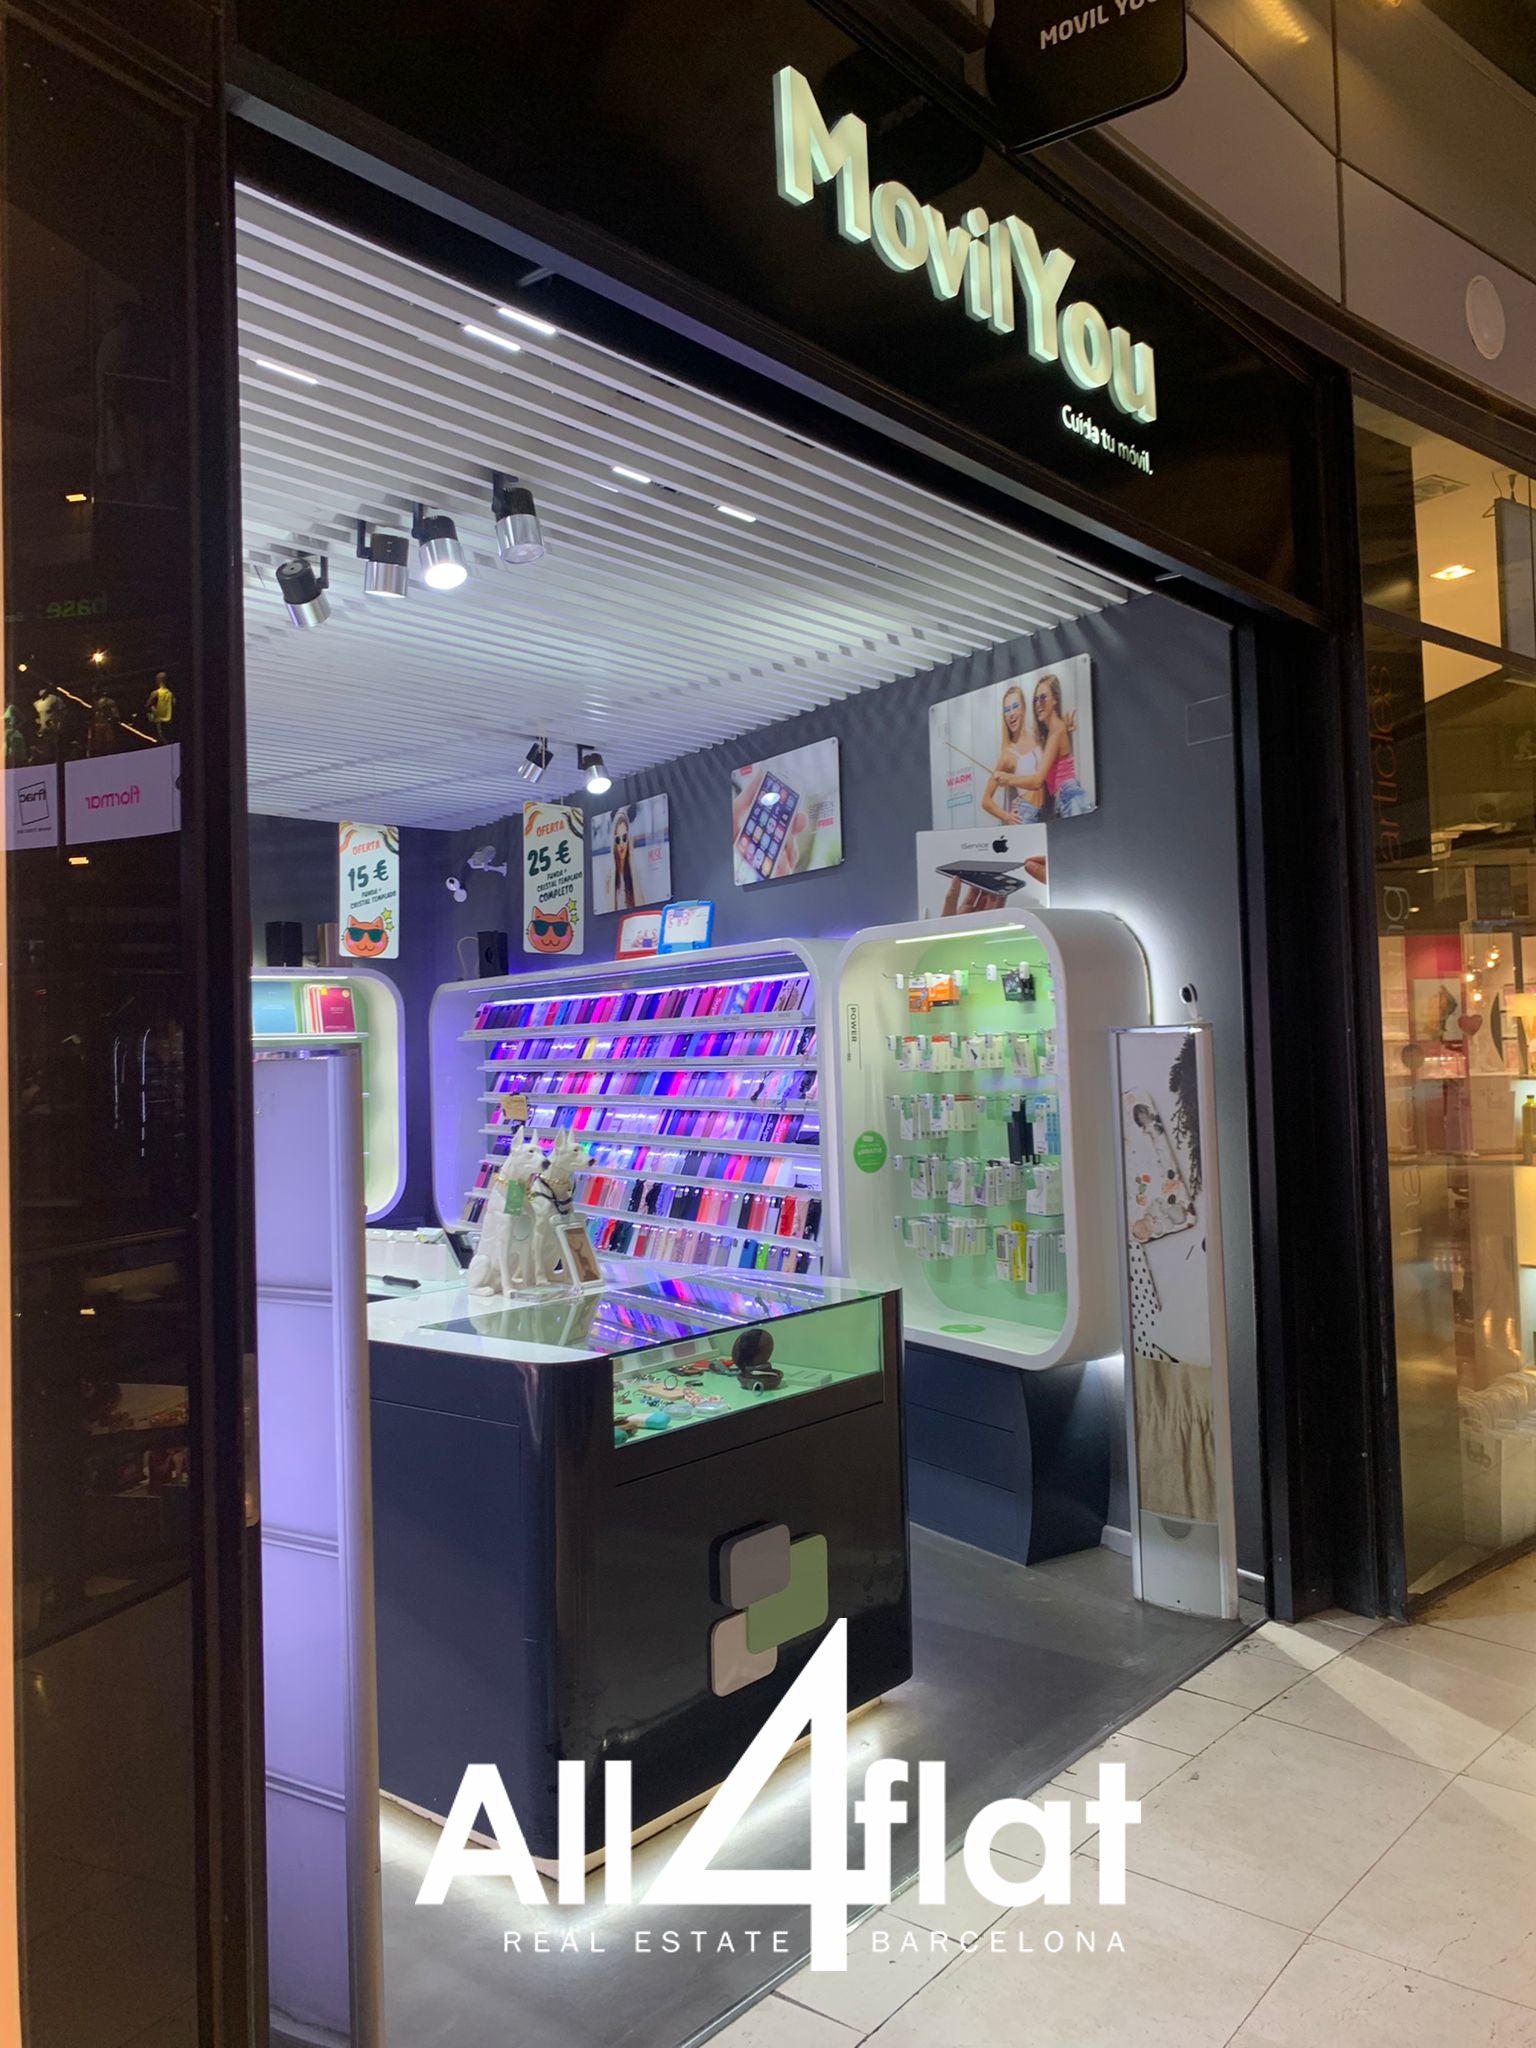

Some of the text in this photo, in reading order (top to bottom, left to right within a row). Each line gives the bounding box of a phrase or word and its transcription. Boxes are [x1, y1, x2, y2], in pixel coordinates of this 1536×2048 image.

[1040, 0, 1157, 50] MOVIL YO
[772, 65, 1157, 424] MovilYou
[1062, 404, 1154, 475] Cuida tu móvil.
[946, 773, 973, 787] WARM
[1369, 664, 1400, 865] articles
[536, 820, 565, 837] OFERTA
[960, 842, 990, 850] iService
[352, 839, 380, 855] OFERTA
[527, 840, 572, 877] 25 €
[347, 859, 389, 892] 15 €
[538, 884, 574, 903] COMPLETO
[850, 1006, 858, 1044] POWER
